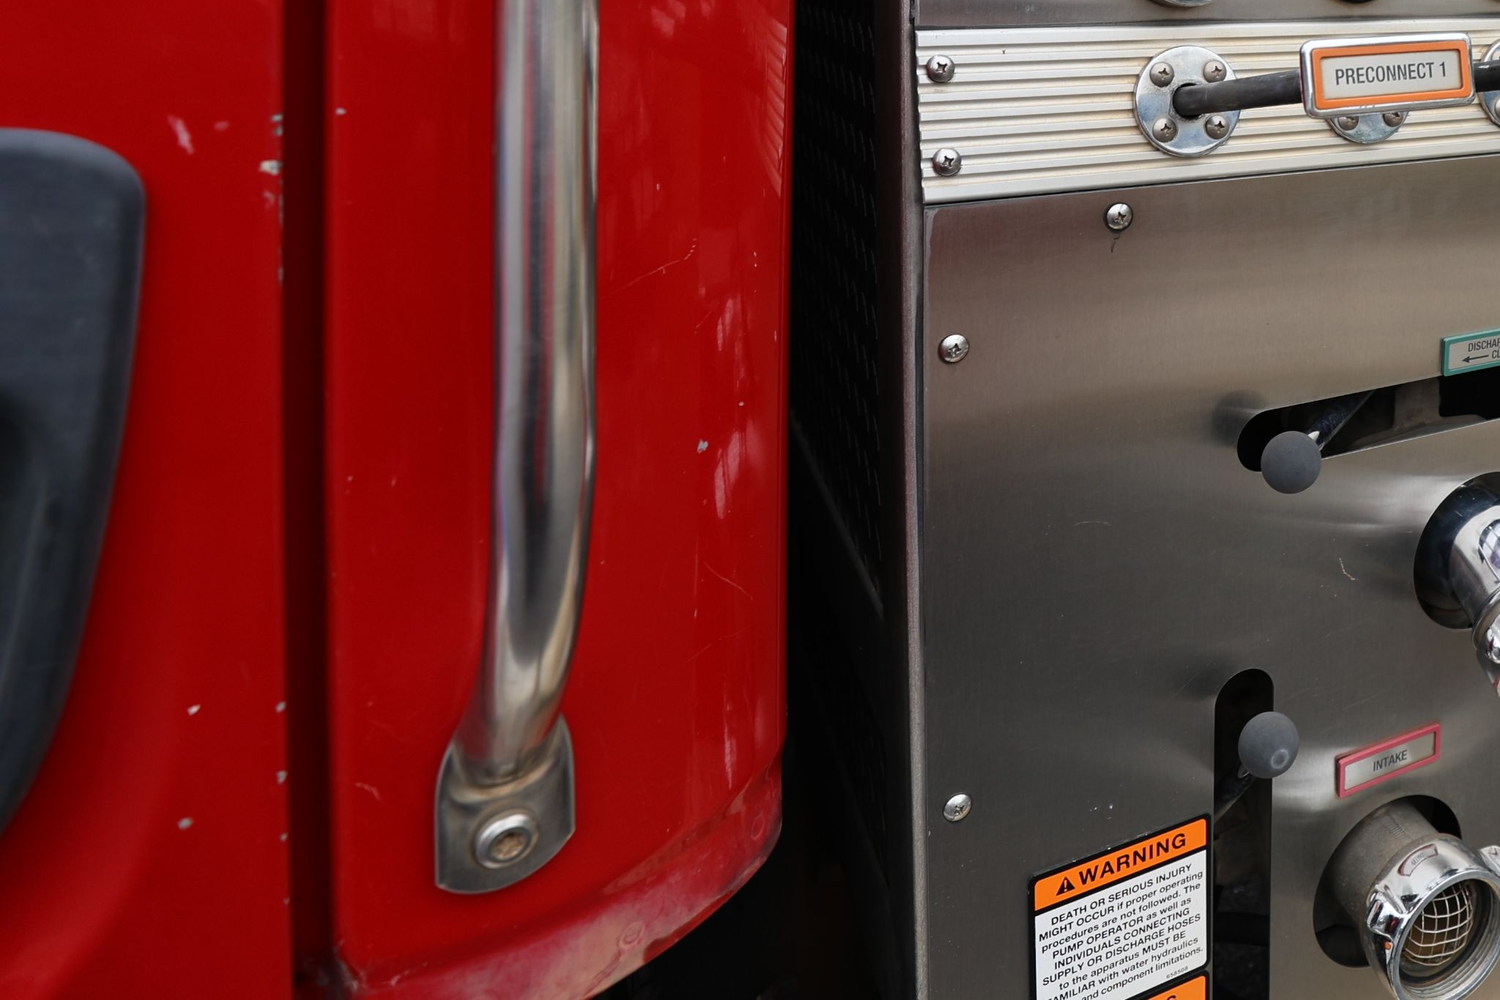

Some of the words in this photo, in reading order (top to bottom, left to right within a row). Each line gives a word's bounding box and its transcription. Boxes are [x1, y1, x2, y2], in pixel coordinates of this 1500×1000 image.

[1335, 62, 1434, 86] PRECONNECT
[1440, 62, 1446, 77] 1
[1373, 750, 1408, 773] INTAKE
[1079, 833, 1186, 885] WARNING
[1039, 922, 1074, 942] MIGHT
[1077, 907, 1115, 926] OCCUR
[1118, 901, 1123, 911] if
[1126, 891, 1156, 910] proper
[1160, 872, 1203, 894] operating
[1042, 924, 1099, 954] procedures
[1102, 917, 1117, 928] are
[1121, 909, 1137, 921] not
[1139, 893, 1181, 913] followed.
[1184, 883, 1201, 894] The
[1052, 906, 1087, 926] DEATH
[1090, 897, 1106, 910] OR
[1109, 879, 1154, 903] SERIOUS
[1156, 863, 1192, 884] INJURY
[1043, 962, 1084, 986] SUPPLY
[1088, 956, 1103, 969] OR
[1106, 929, 1165, 959] DISCHARGE
[1168, 914, 1201, 933] HOSES
[1053, 941, 1084, 959] PUMP
[1087, 916, 1143, 945] OPERATOR
[1147, 912, 1157, 921] as
[1160, 903, 1178, 916] well
[1181, 898, 1192, 906] as
[1055, 936, 1121, 970] INDIVIDUALS
[1124, 908, 1190, 941] CONNECTING
[1048, 981, 1096, 1000] AMILIAR
[1099, 973, 1119, 985] with
[1122, 960, 1149, 975] water
[1152, 937, 1199, 963] hydraulics
[1060, 982, 1070, 990] to
[1073, 973, 1088, 985] the
[1091, 953, 1140, 978] apparatus
[1143, 937, 1170, 954] MUST
[1173, 931, 1186, 942] BE
[1082, 990, 1099, 1000] and
[1101, 968, 1153, 994] component
[1156, 948, 1204, 971] limitations.
